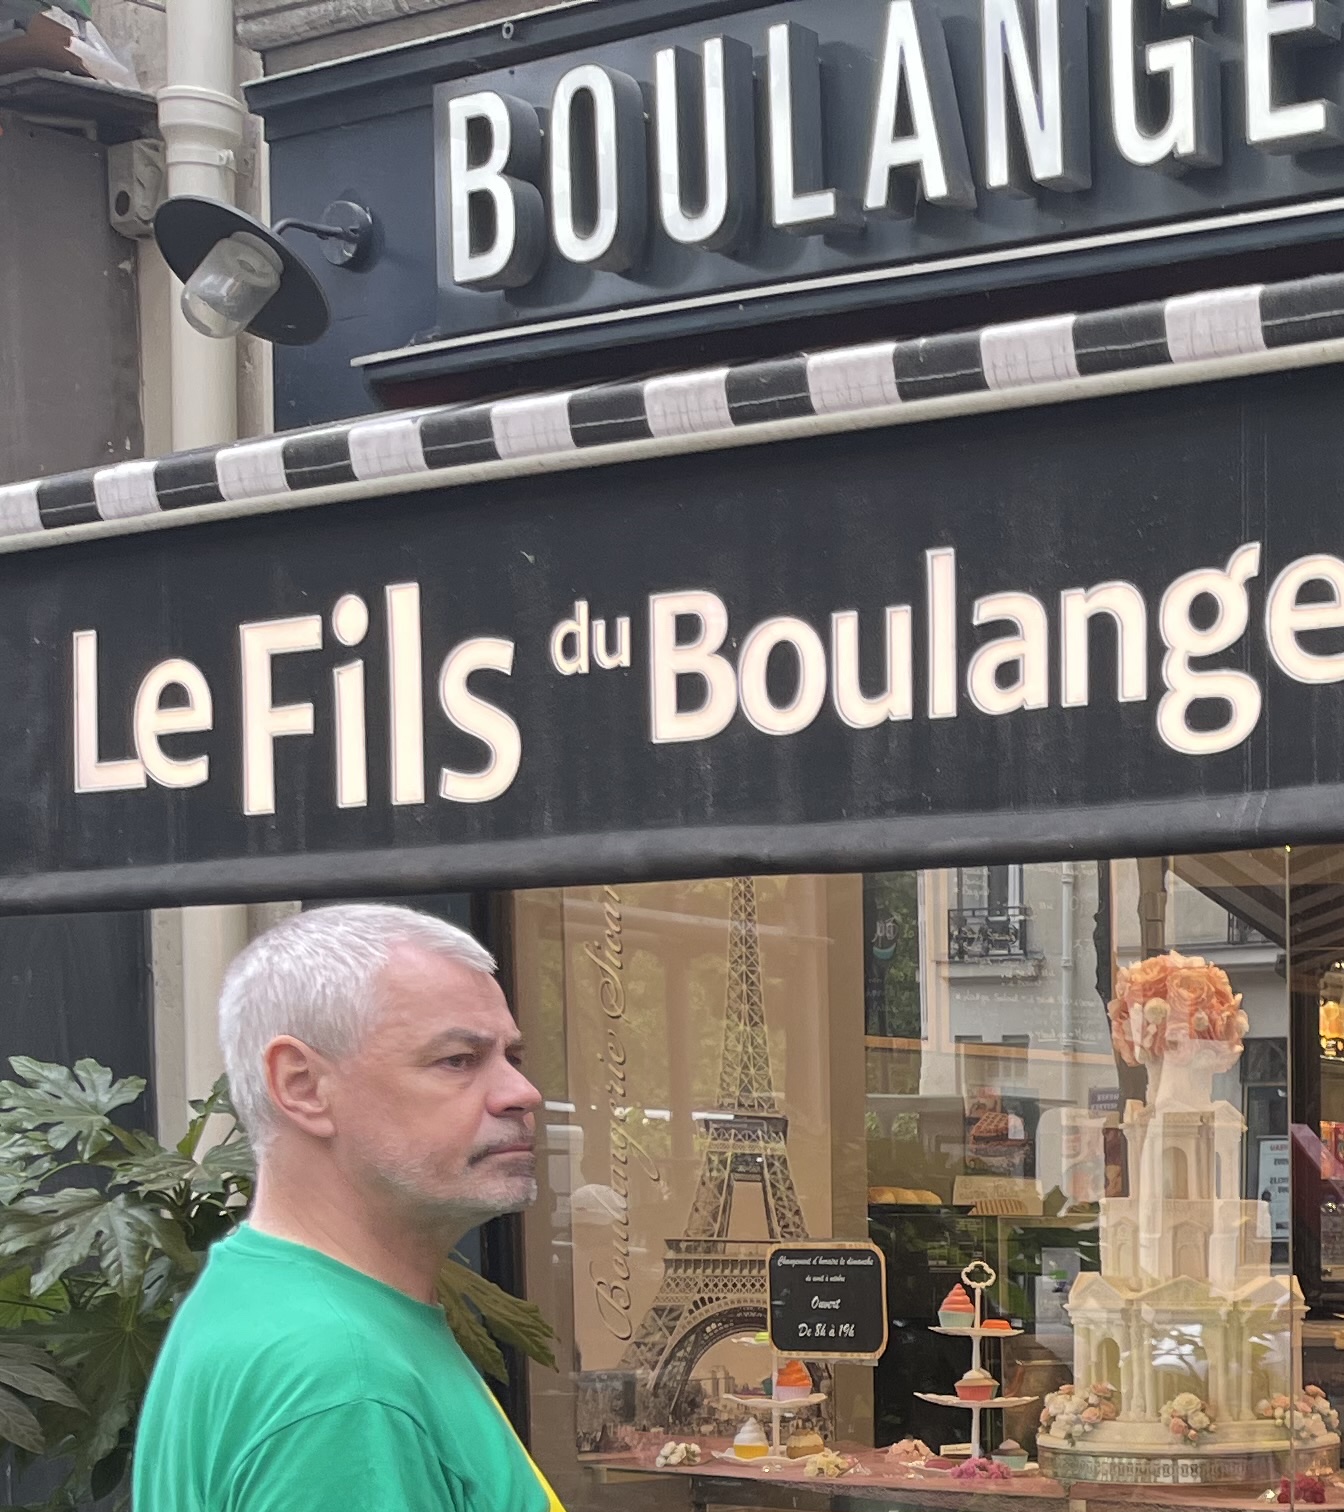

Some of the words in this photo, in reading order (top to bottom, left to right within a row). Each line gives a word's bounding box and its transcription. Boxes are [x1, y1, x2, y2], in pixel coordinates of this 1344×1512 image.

[73, 630, 213, 793] Le
[239, 582, 522, 816] Fils
[550, 600, 630, 677] du
[798, 1323, 812, 1337] De
